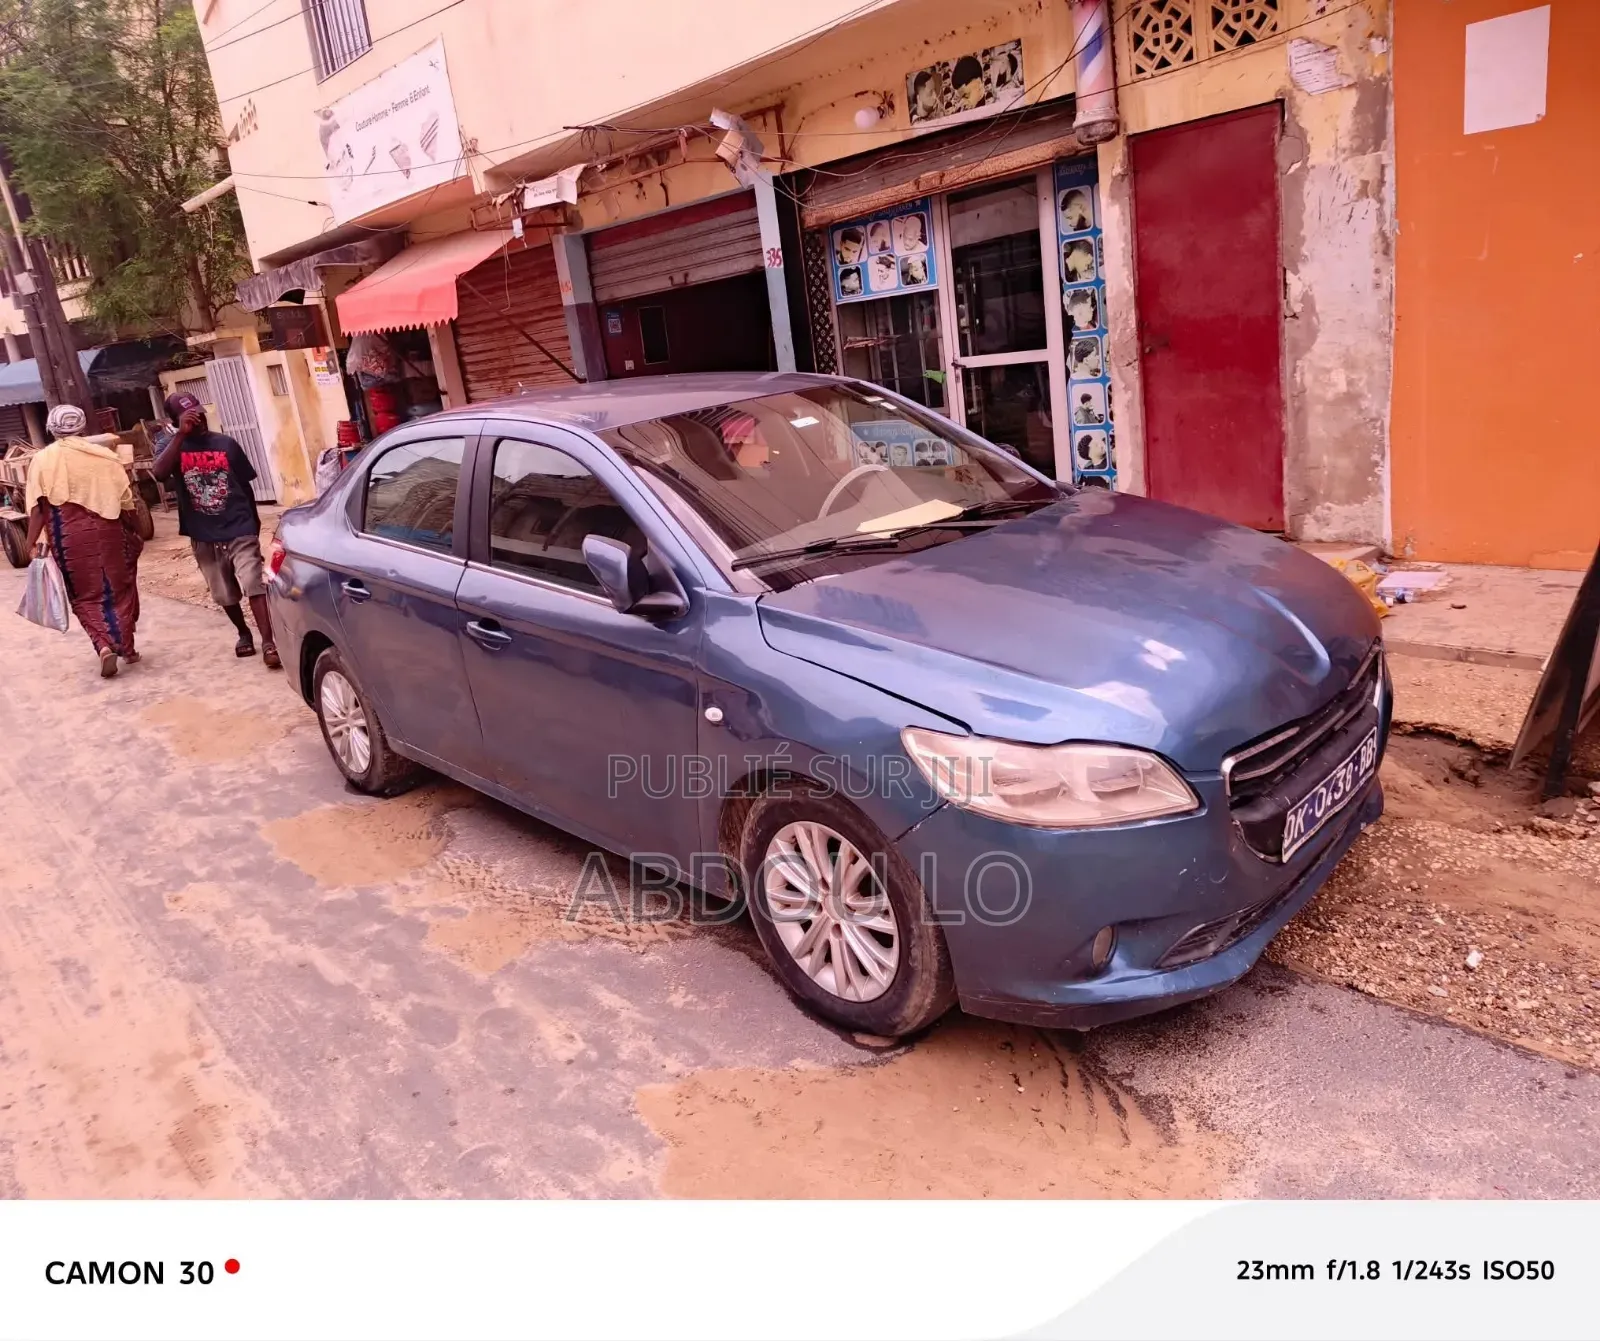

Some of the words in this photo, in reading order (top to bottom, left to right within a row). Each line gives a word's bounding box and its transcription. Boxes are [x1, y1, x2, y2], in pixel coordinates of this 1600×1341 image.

[355, 117, 372, 132] Couture
[372, 109, 388, 124] Homme
[391, 99, 409, 113] Femme
[413, 85, 430, 101] Enfant
